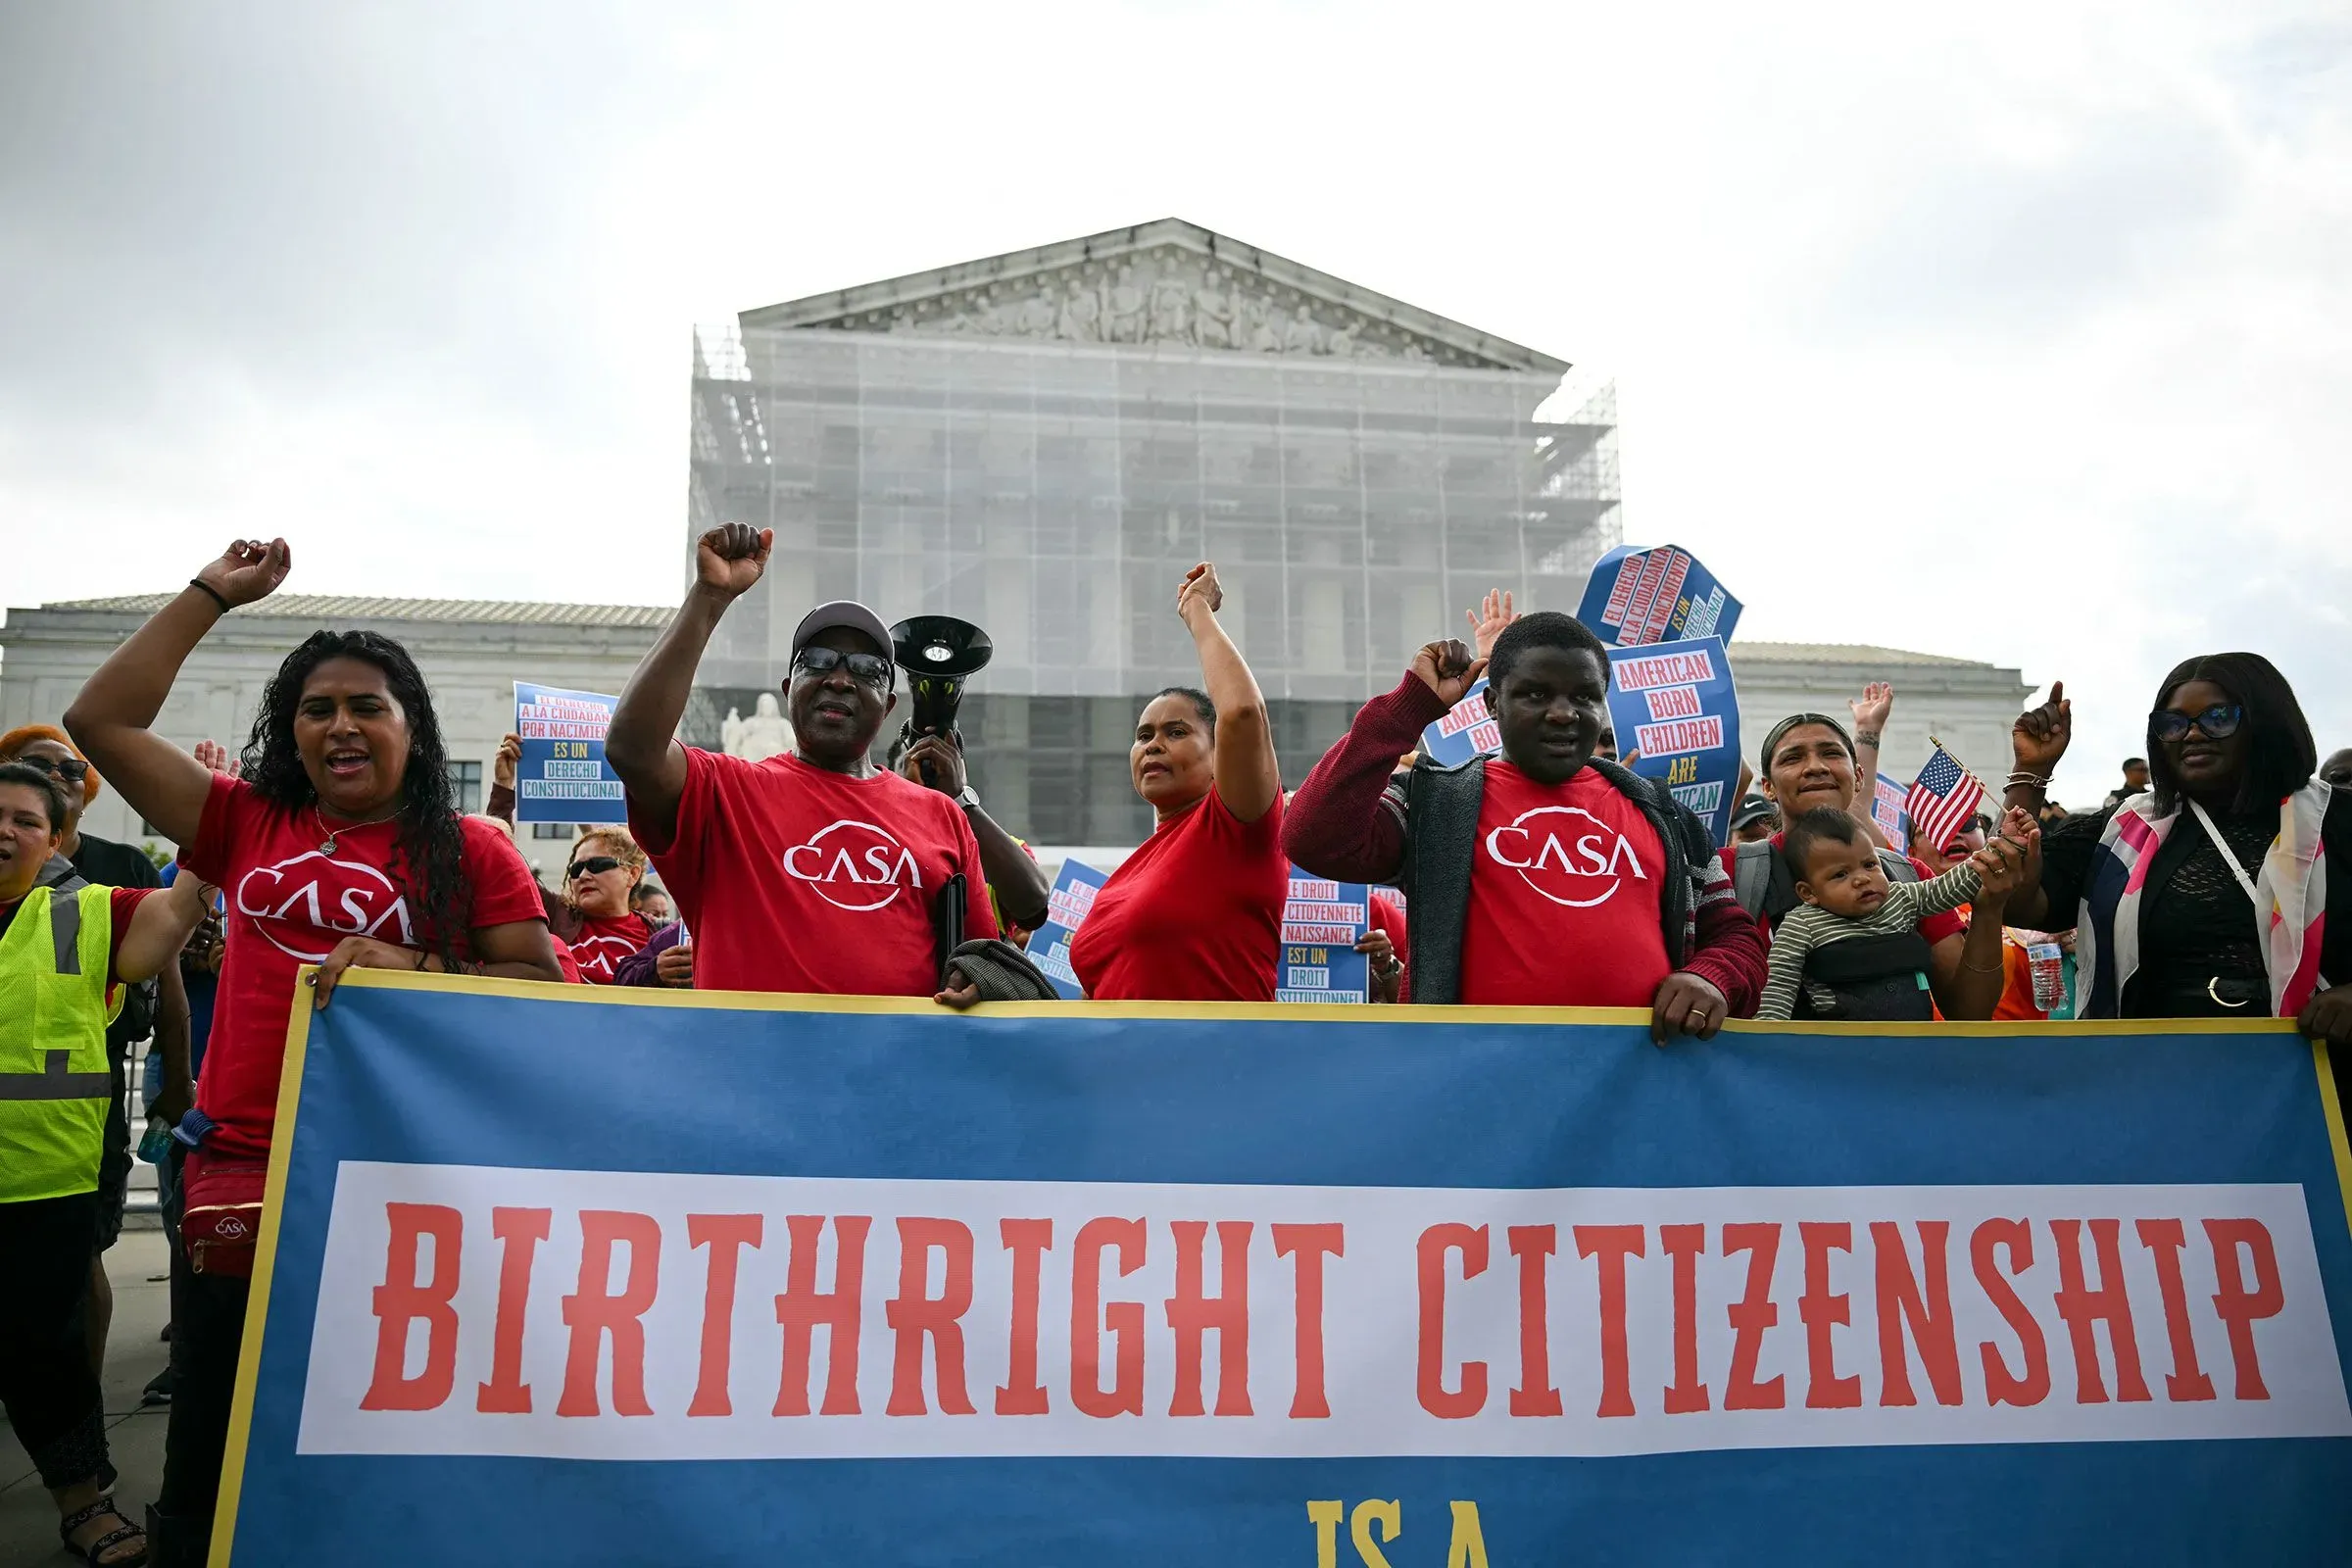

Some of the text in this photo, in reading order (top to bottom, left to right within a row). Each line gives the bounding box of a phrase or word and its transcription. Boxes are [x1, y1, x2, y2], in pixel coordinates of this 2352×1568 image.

[1604, 557, 1643, 622] EL DERECHO
[1649, 553, 1690, 625] NACIMIENTO
[1671, 596, 1690, 632] ES UN
[1626, 619, 1642, 635] LA
[1620, 634, 1635, 646] A
[1618, 654, 1711, 689] AMERICAN
[1647, 688, 1698, 718] BORN
[522, 706, 610, 723] A LA CIUDADAN
[522, 721, 608, 739] POR NACIMIEN
[1640, 718, 1720, 755] CHILDREN
[555, 742, 588, 759] ES UN
[548, 761, 598, 778] DERECHO
[1667, 756, 1698, 784] ARE
[524, 781, 621, 799] CONSTITUCIONAL
[1486, 826, 1647, 879] CASA
[783, 845, 923, 889] CASA
[1302, 882, 1336, 899] DROIT
[237, 867, 418, 945] CASA
[1286, 925, 1352, 944] NAISSANCE
[1287, 947, 1327, 964] EST UN
[1291, 969, 1326, 986] DROIT
[1276, 991, 1358, 1004] STITUTIONNEL
[216, 1222, 248, 1234] CASA
[360, 1201, 2284, 1420] BIRTHRIGHT CITIZENSHIP
